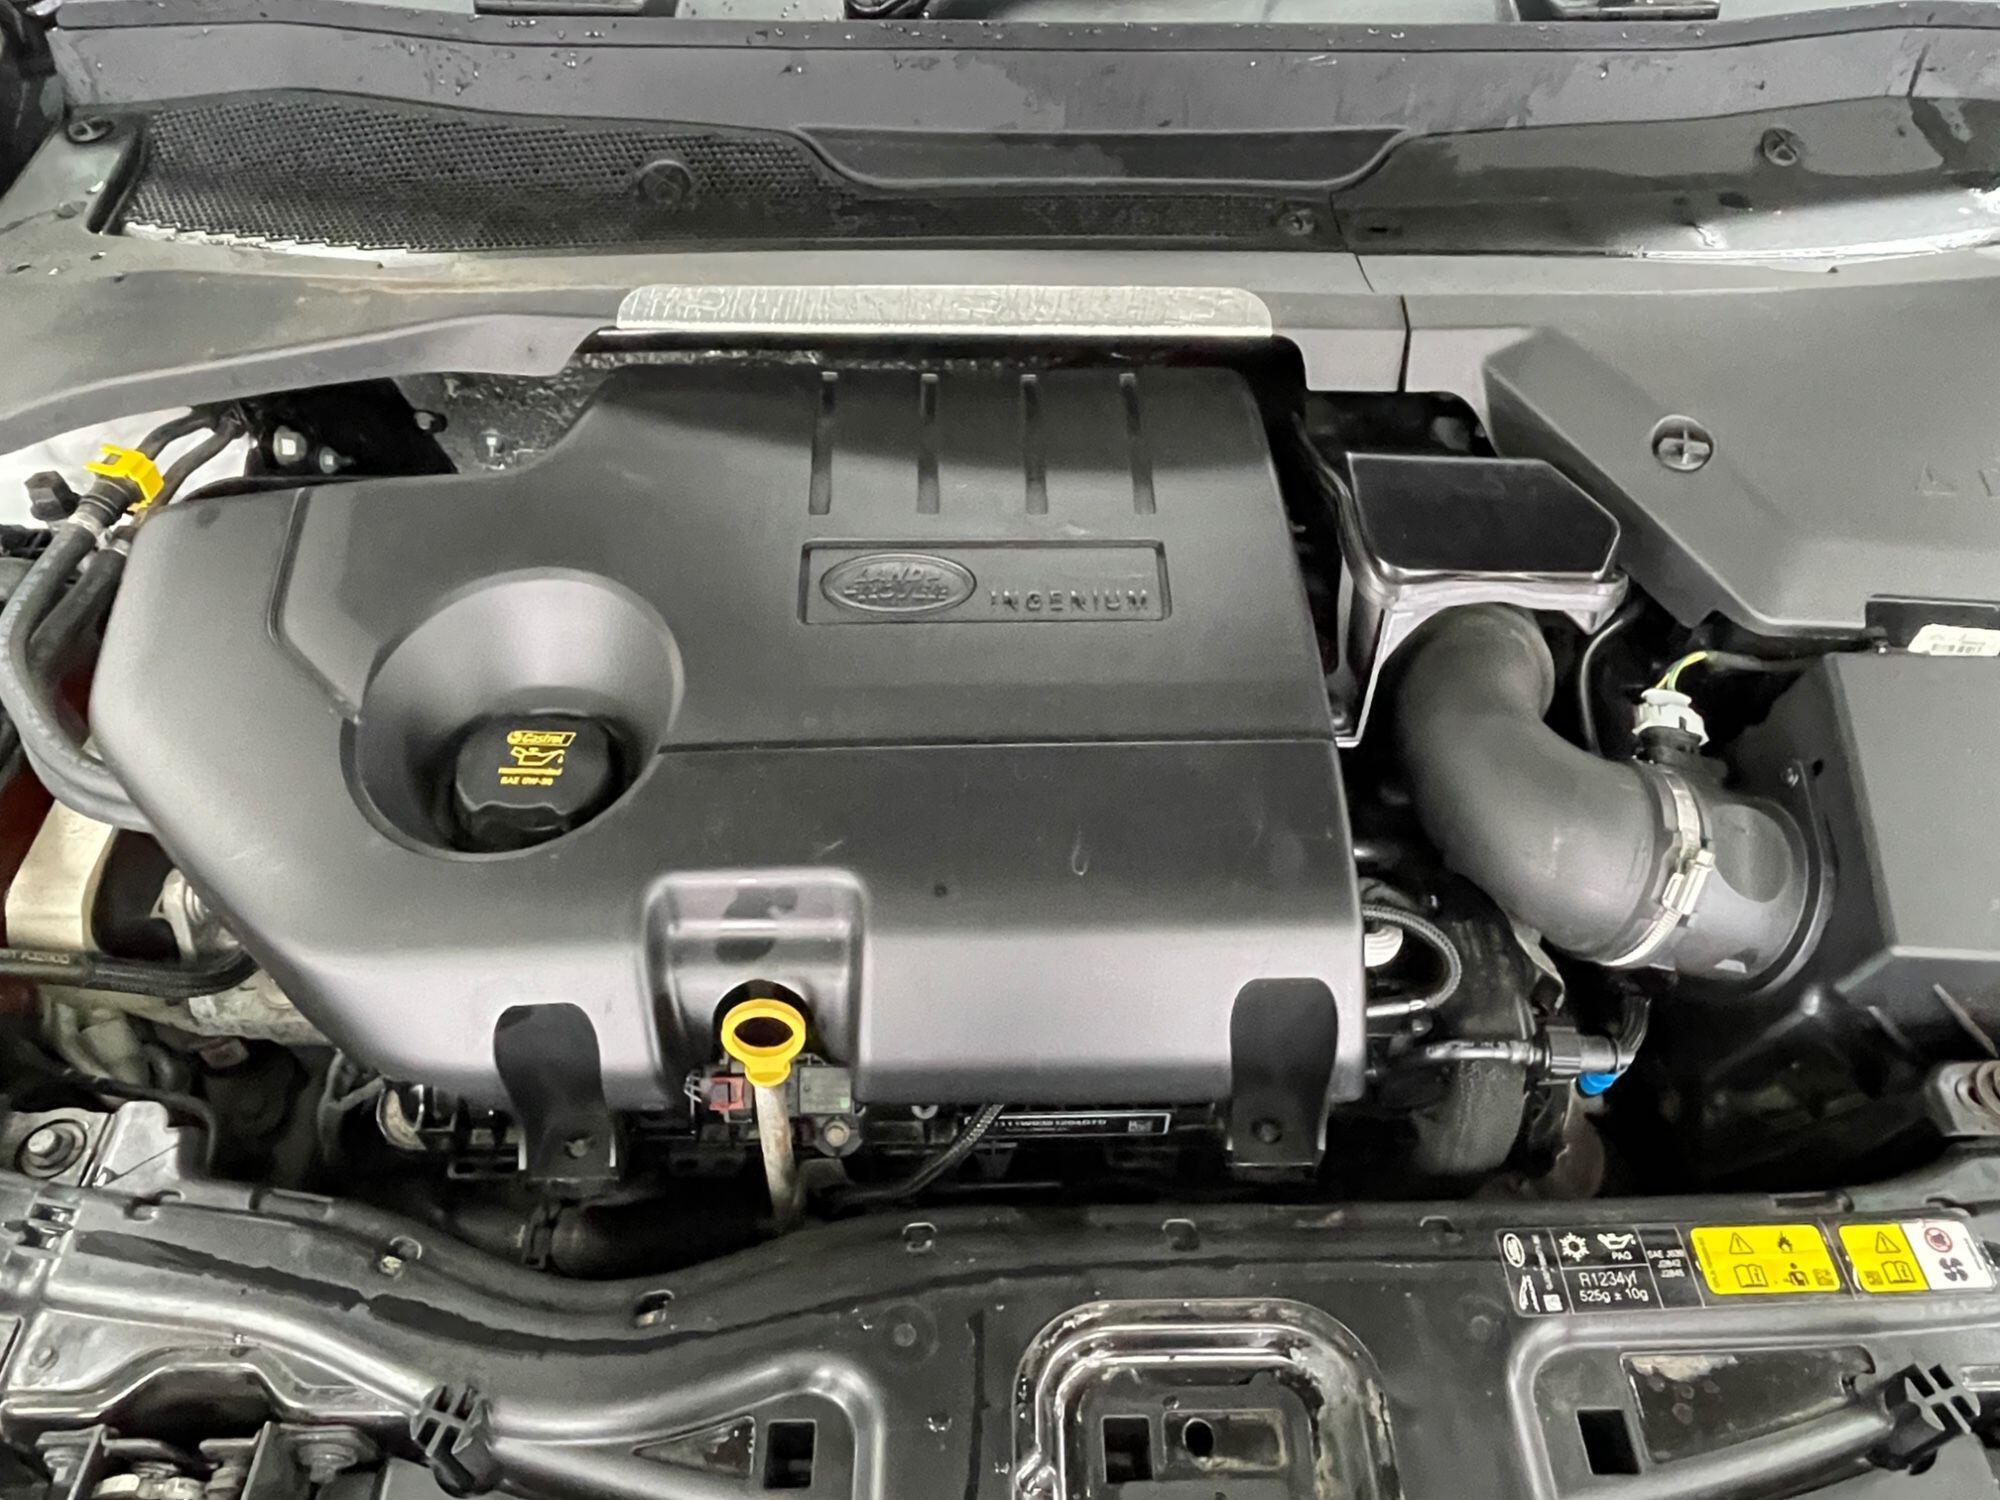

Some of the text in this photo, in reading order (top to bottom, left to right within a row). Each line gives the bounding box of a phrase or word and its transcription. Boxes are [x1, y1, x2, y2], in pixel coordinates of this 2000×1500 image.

[989, 589, 1149, 612] INGENIUM
[522, 732, 565, 745] Castrol
[1578, 1270, 1637, 1288] R1234yf
[1579, 1288, 1611, 1303] 525g
[1625, 1287, 1649, 1302] 10g
